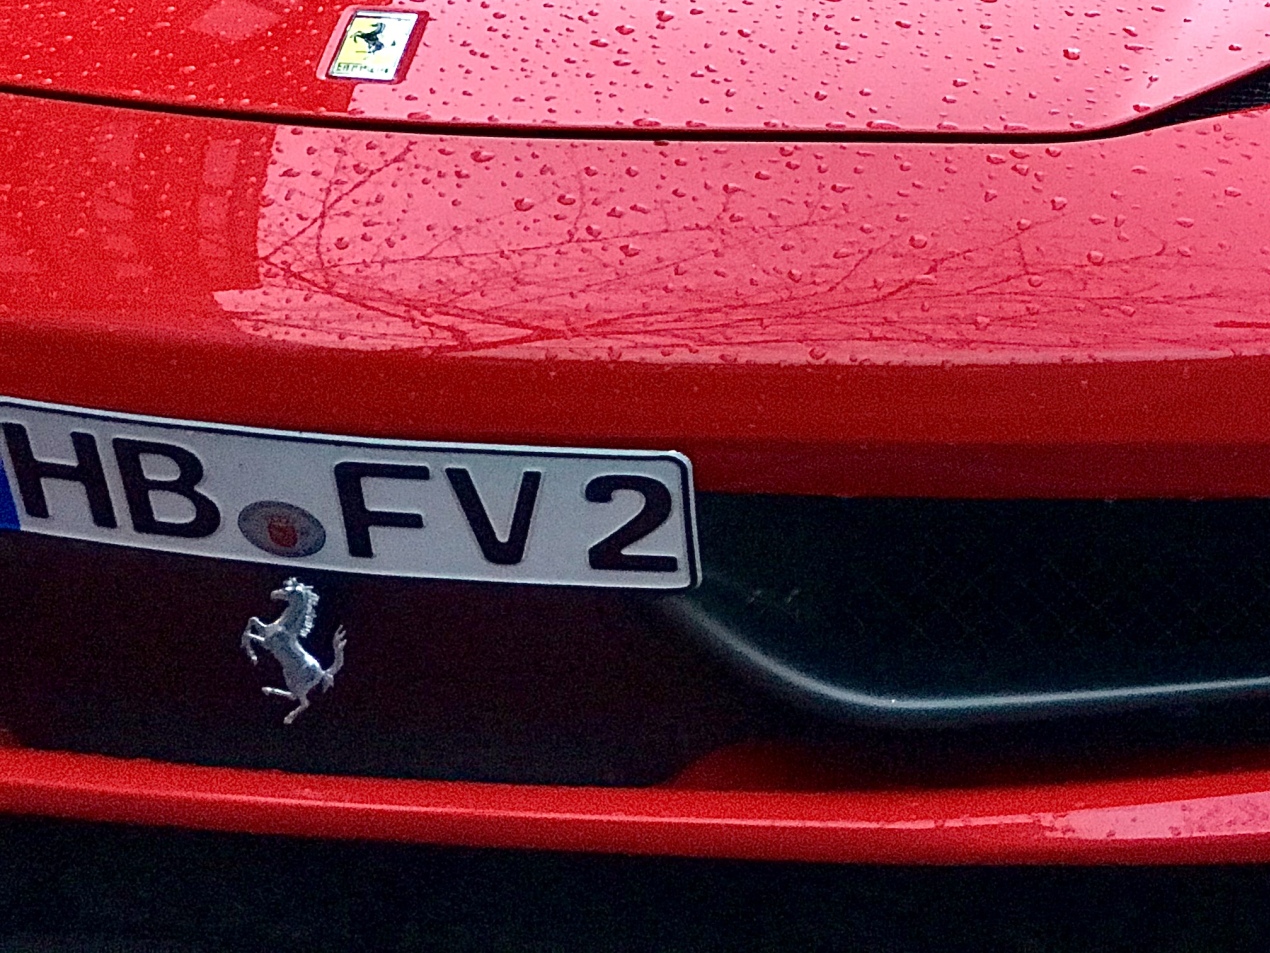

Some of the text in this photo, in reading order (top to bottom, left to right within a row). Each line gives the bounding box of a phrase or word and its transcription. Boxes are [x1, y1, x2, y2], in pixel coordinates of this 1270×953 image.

[1, 422, 678, 572] HB FV 2
